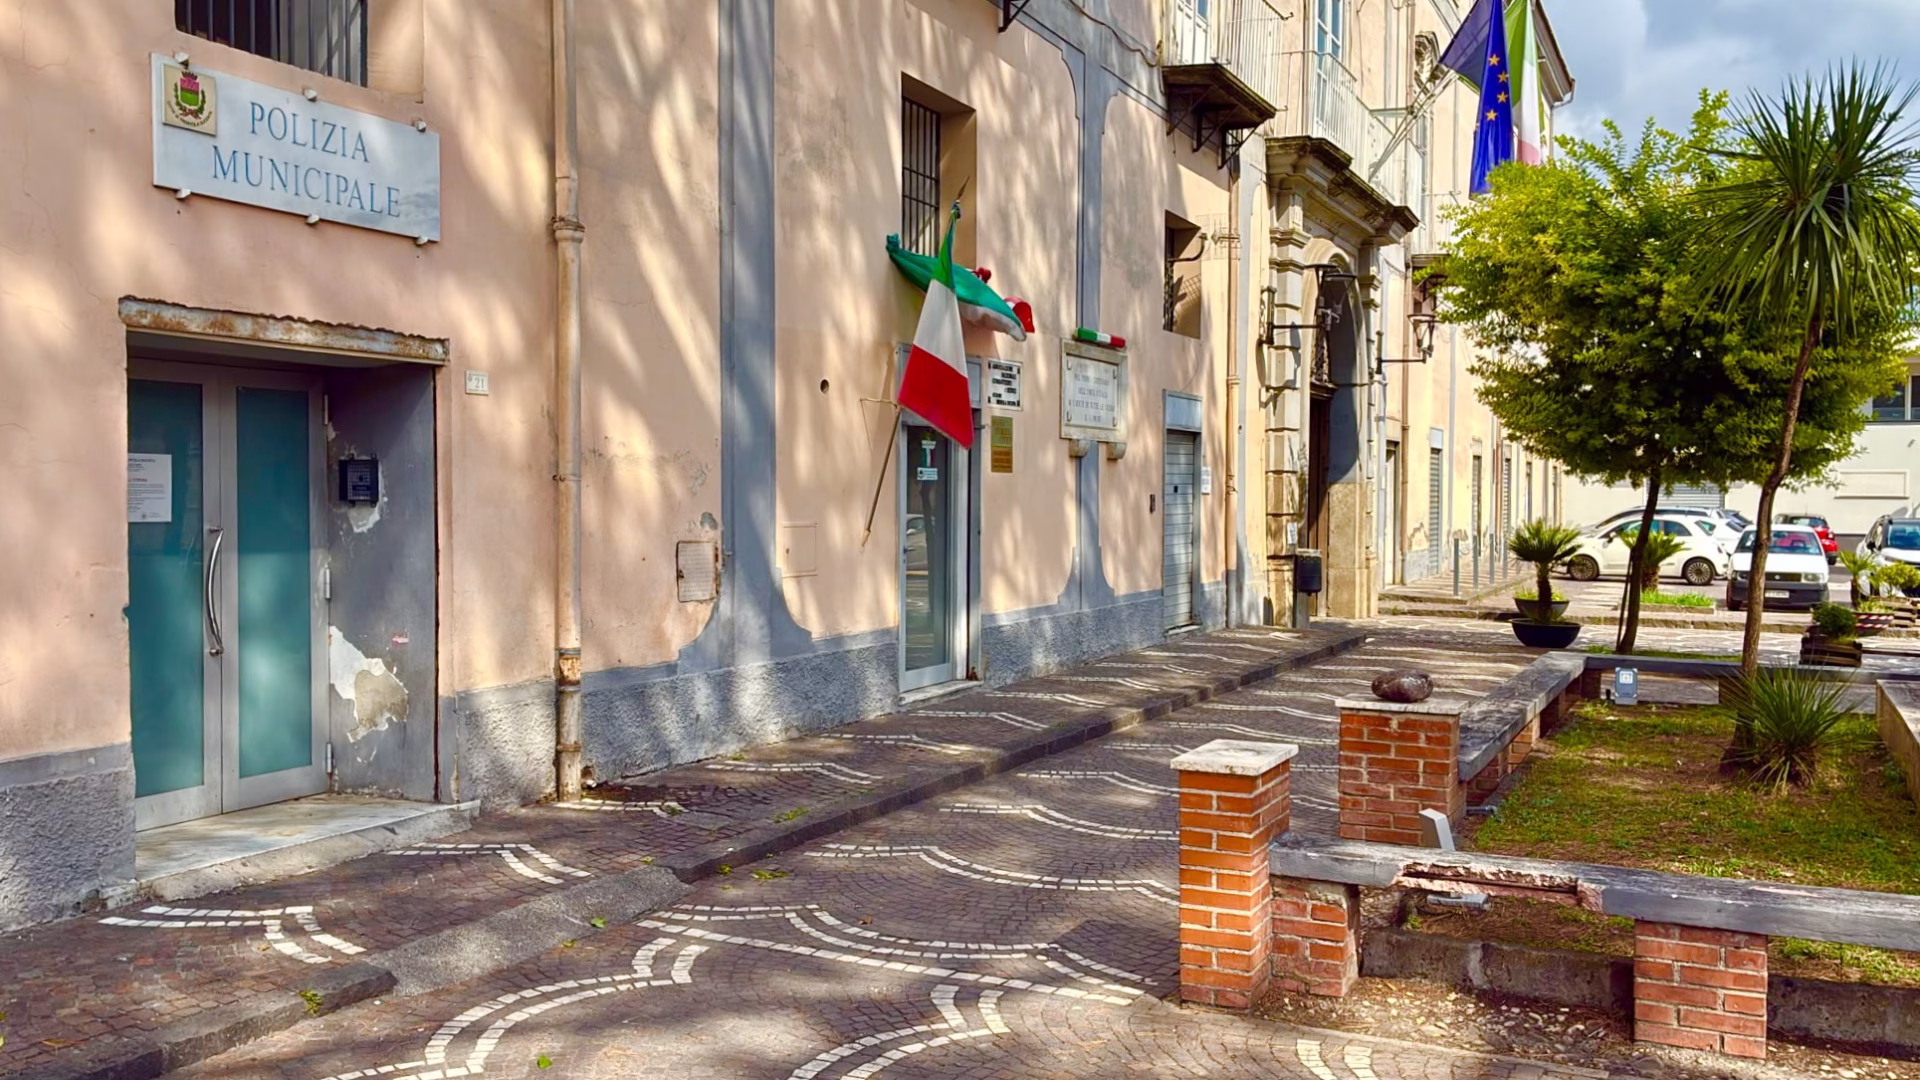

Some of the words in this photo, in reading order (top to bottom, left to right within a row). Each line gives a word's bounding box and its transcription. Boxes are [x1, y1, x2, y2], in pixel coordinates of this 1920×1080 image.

[250, 102, 370, 163] POLIZIA
[212, 145, 401, 218] MUNICIPALE
[474, 376, 485, 389] 21
